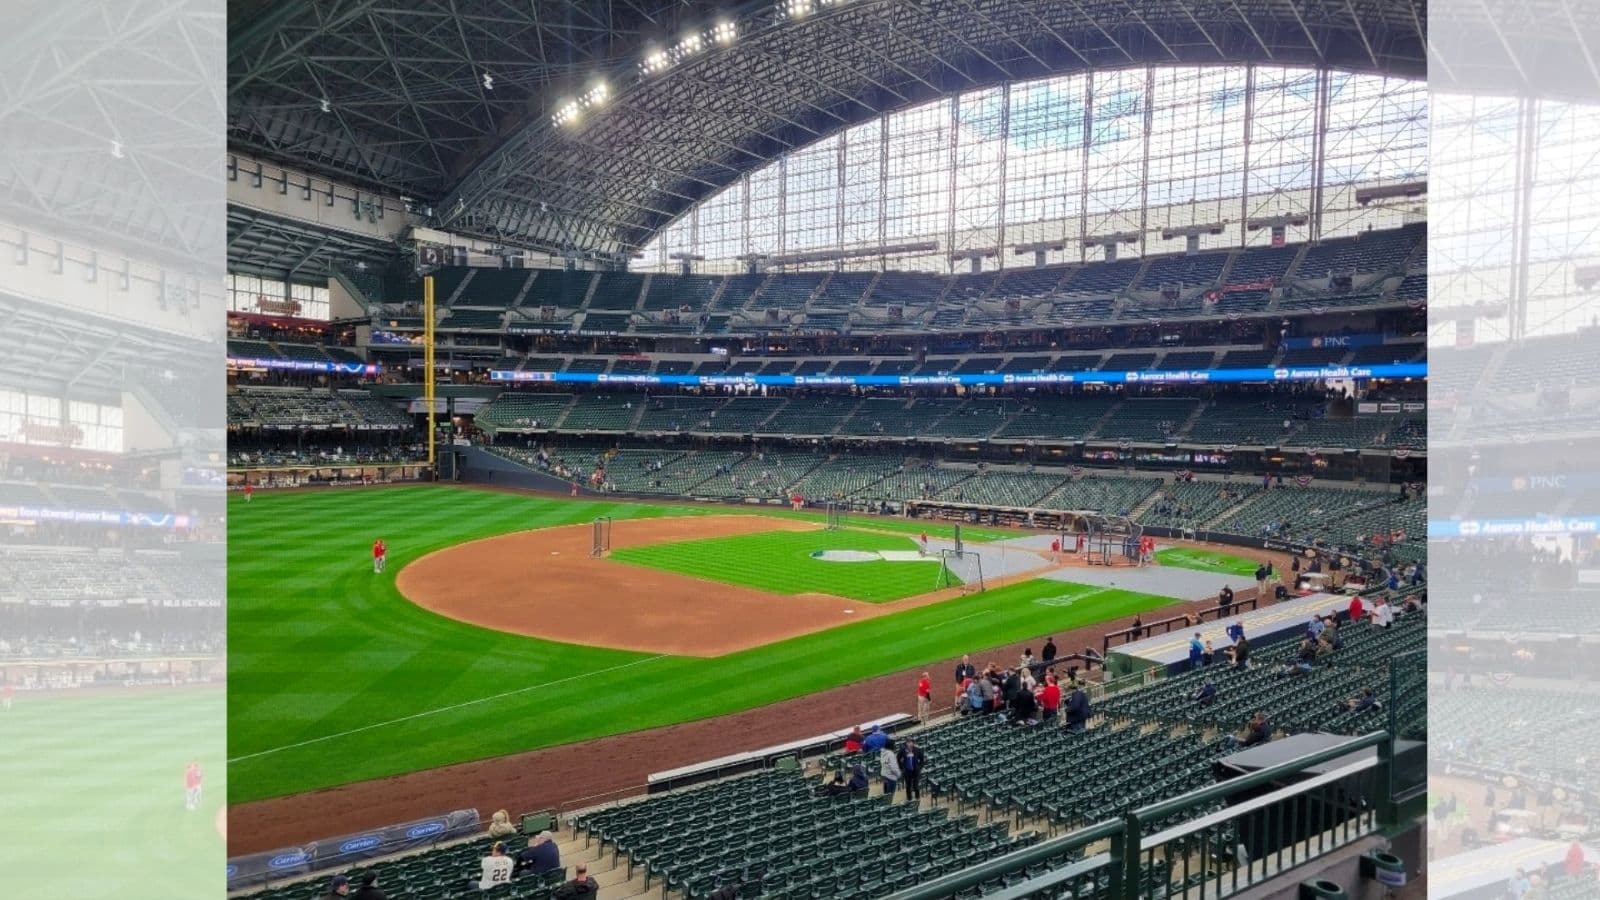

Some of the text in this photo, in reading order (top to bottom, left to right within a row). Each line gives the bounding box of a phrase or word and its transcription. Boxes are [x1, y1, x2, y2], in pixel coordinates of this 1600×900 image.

[1324, 336, 1350, 347] PNC
[296, 361, 314, 369] power
[1015, 373, 1073, 382] Aurora Health Care
[1140, 371, 1209, 381] Aurora Health Care
[1291, 367, 1371, 378] Aurora Health Care
[1524, 519, 1565, 532] Health
[412, 824, 441, 836] Carrier
[348, 839, 376, 849] Carrier
[492, 868, 507, 881] 22
